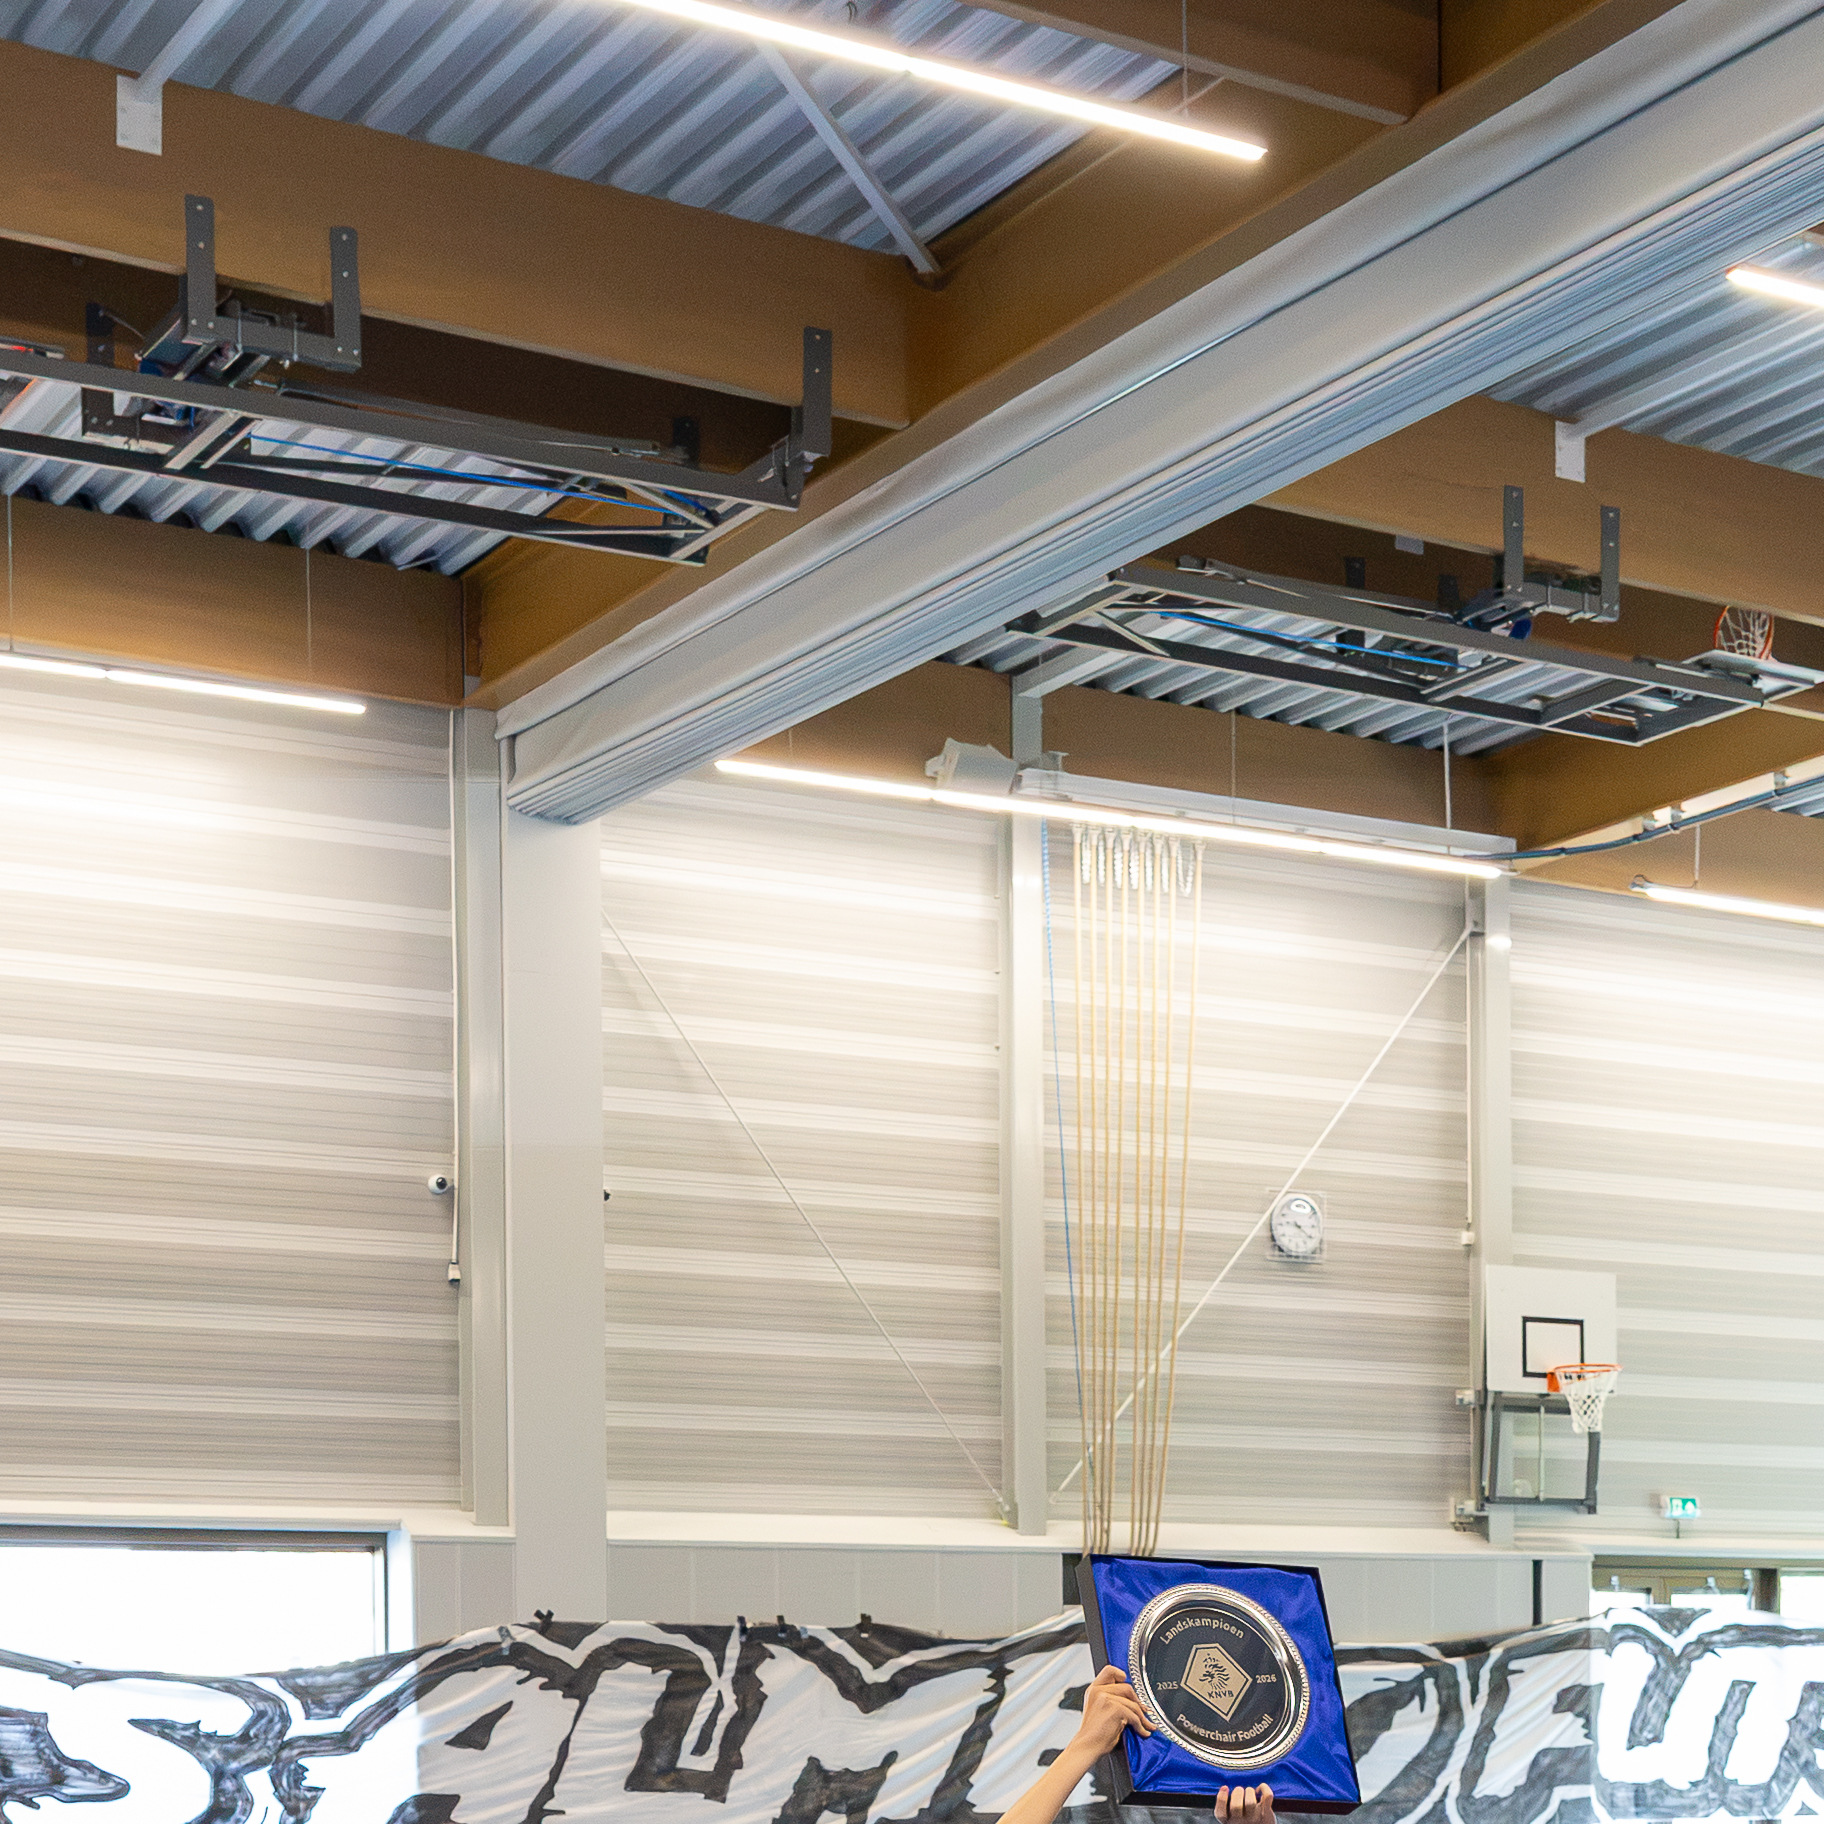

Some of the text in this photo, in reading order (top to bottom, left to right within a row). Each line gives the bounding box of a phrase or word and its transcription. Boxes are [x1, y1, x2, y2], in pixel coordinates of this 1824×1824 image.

[1160, 1617, 1245, 1645] Landskampioen
[1156, 1674, 1277, 1691] 2025 2026
[1207, 1690, 1234, 1699] KNVB
[1177, 1713, 1274, 1742] Powerchair Football
